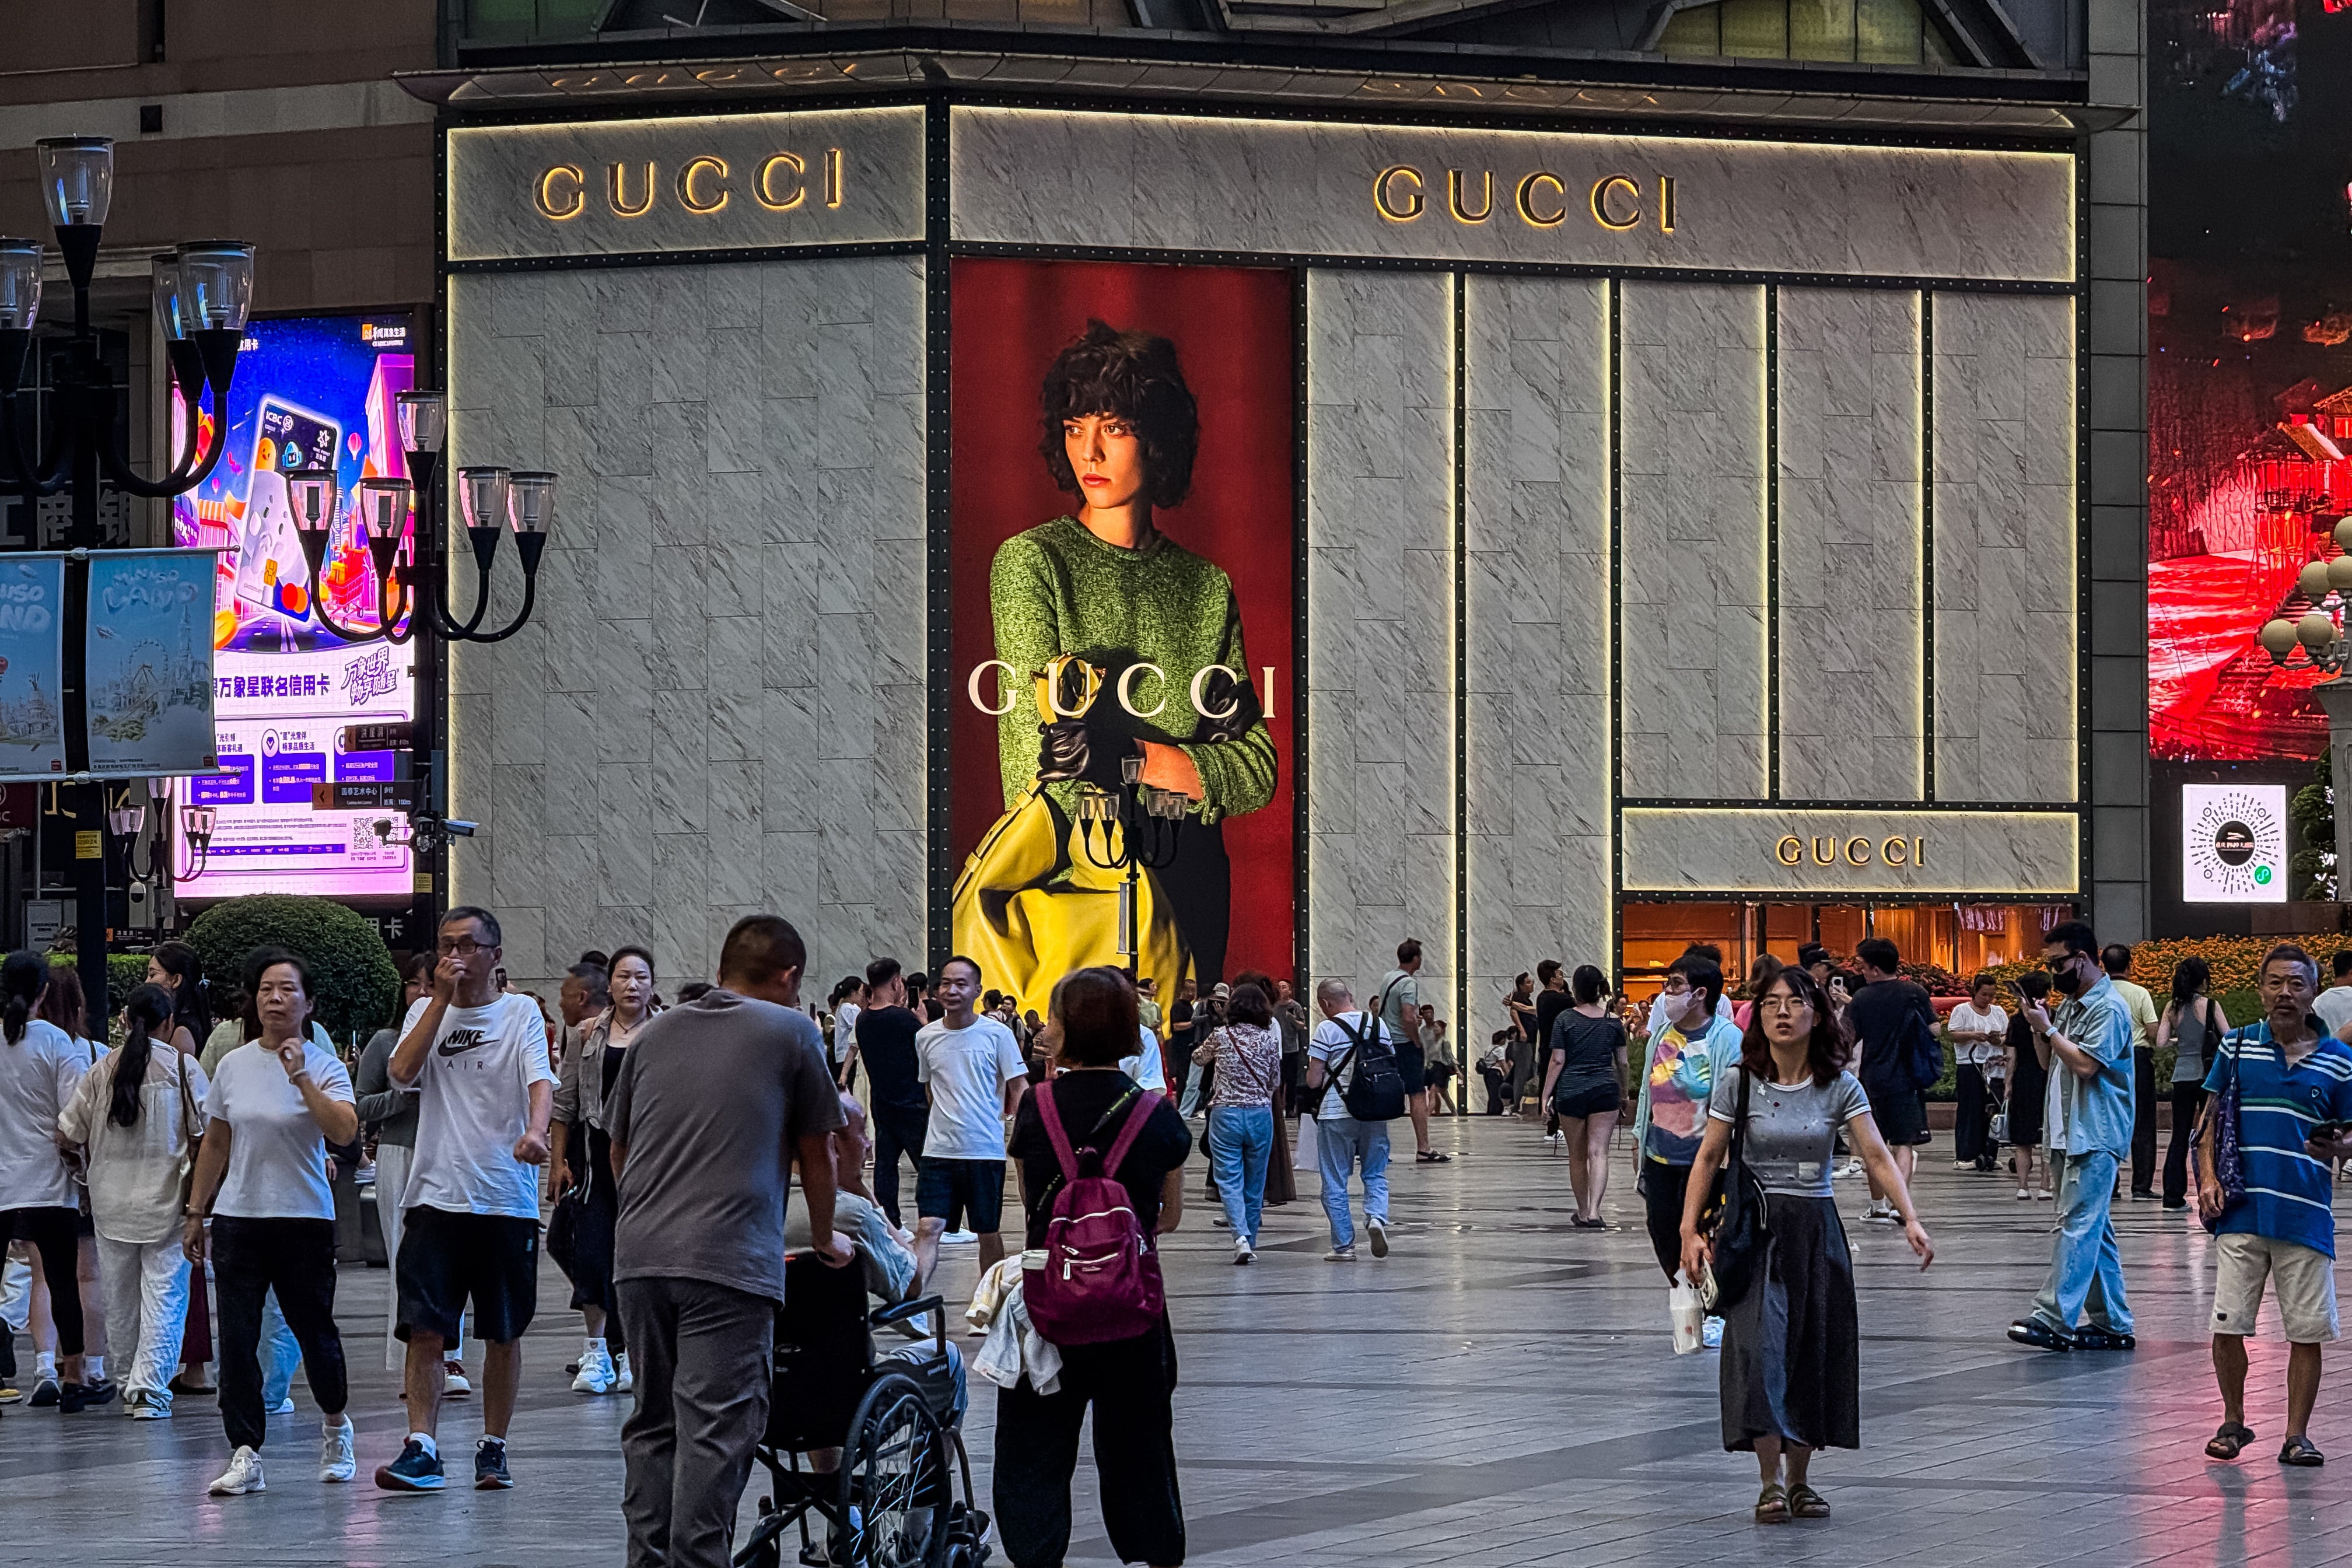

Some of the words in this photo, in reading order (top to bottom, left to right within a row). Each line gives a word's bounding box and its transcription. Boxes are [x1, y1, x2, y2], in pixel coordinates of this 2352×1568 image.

[534, 148, 841, 220] GUCCI
[1374, 166, 1675, 233] GUCCI
[265, 410, 283, 425] ICBC
[341, 646, 389, 690] 万象世界
[968, 659, 1276, 719] GUCCI
[1776, 835, 1924, 866] GUCCI
[447, 1030, 486, 1045] NIKE
[446, 1059, 484, 1070] AIR
